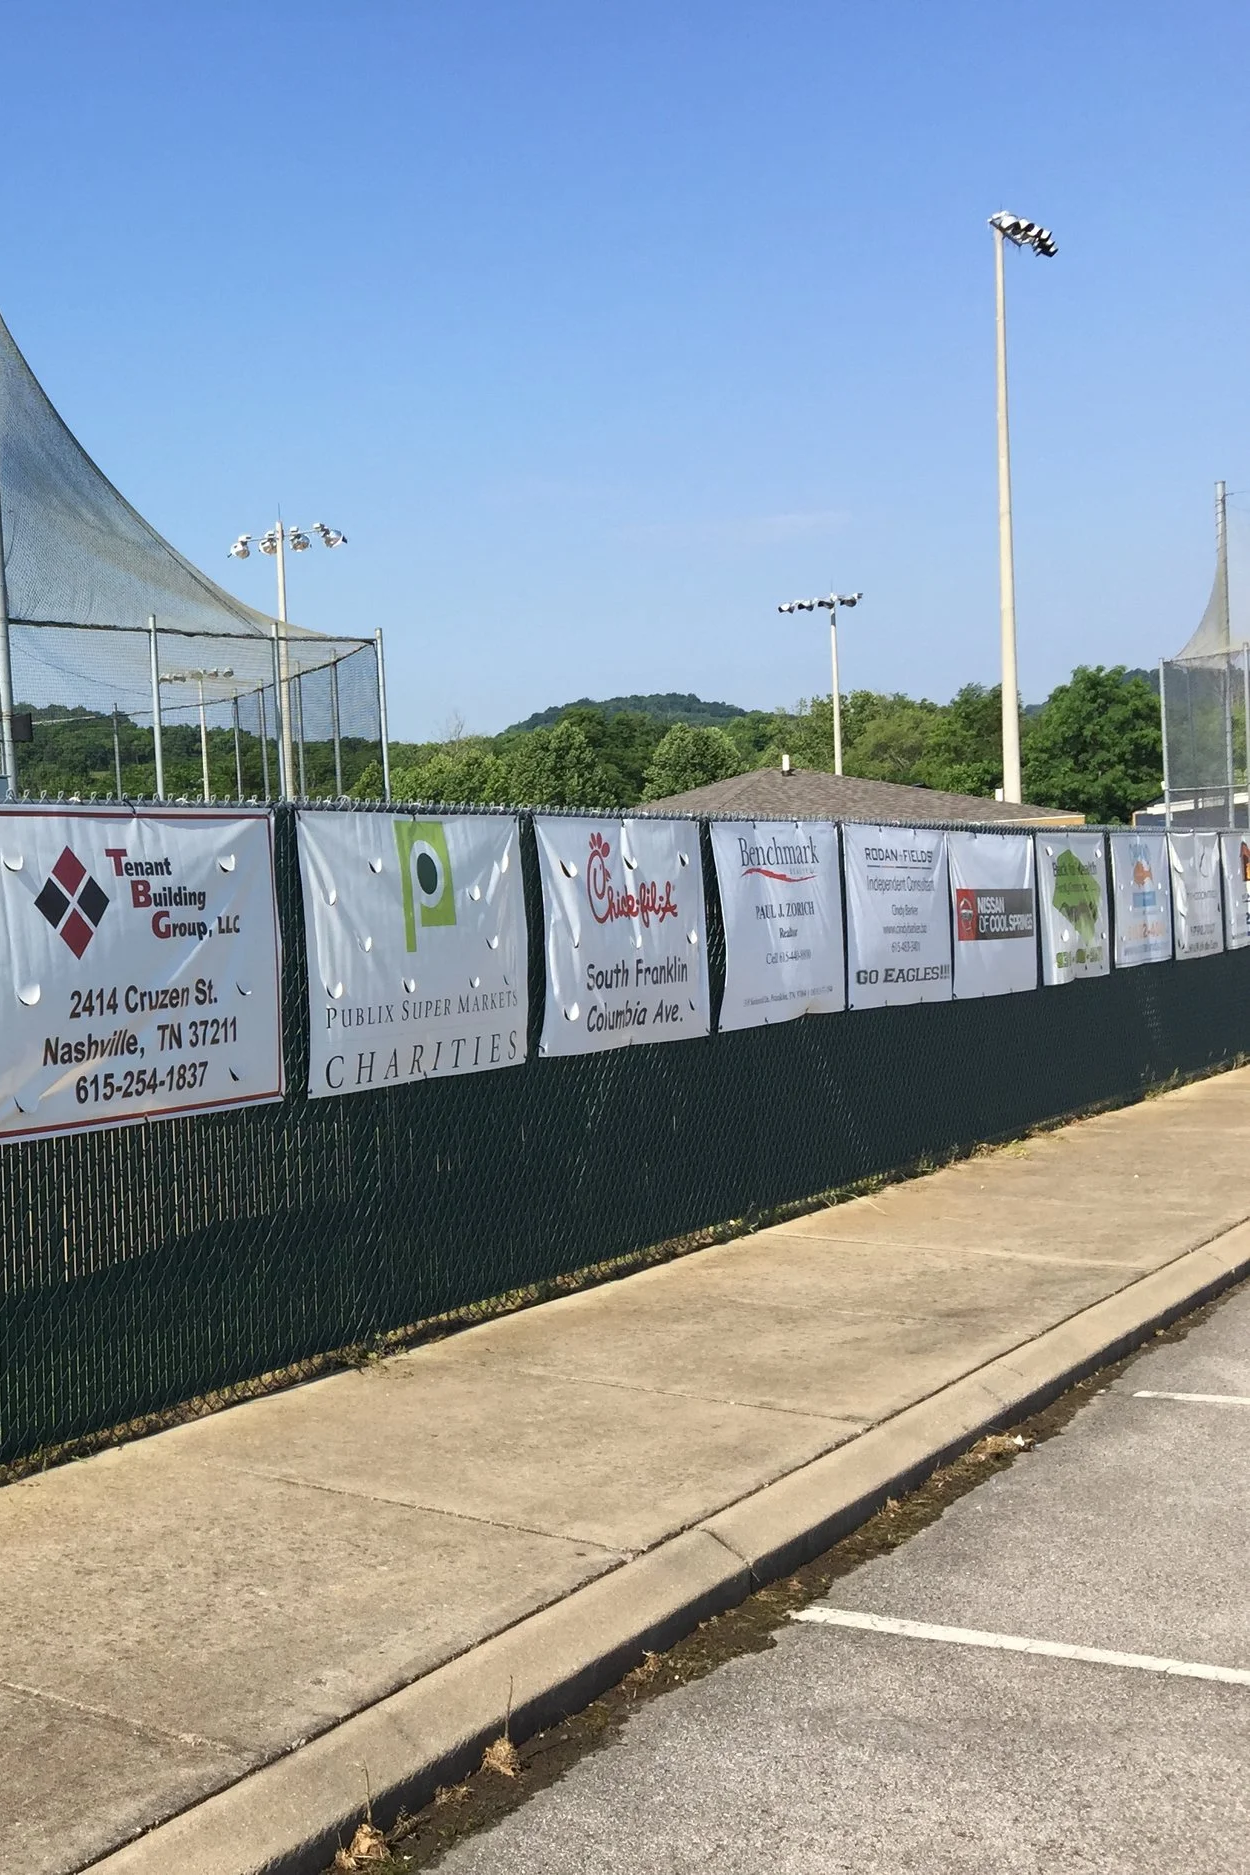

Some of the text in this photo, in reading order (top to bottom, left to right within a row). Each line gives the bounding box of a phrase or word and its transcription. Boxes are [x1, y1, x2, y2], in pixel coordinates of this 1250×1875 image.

[105, 848, 172, 877] Tenant
[737, 835, 820, 868] Benchmark
[130, 879, 206, 911] Building
[755, 901, 815, 920] PAUL J. ZORICH
[977, 896, 1006, 914] NISSAN
[151, 910, 240, 941] Group, LLC
[978, 915, 989, 933] OF
[990, 914, 1008, 933] COOL
[587, 956, 688, 991] South Franklin
[855, 963, 951, 985] GO EAGLES!!!
[69, 978, 218, 1019] 2414 Cruzen St.
[325, 989, 519, 1029] PUBLIX SUPER MARKETS
[586, 998, 684, 1033] Columbia Ave.
[42, 1016, 238, 1067] Nashville, TN 37211
[325, 1029, 518, 1090] CHARITIES
[75, 1061, 209, 1105] 615-254-1837
